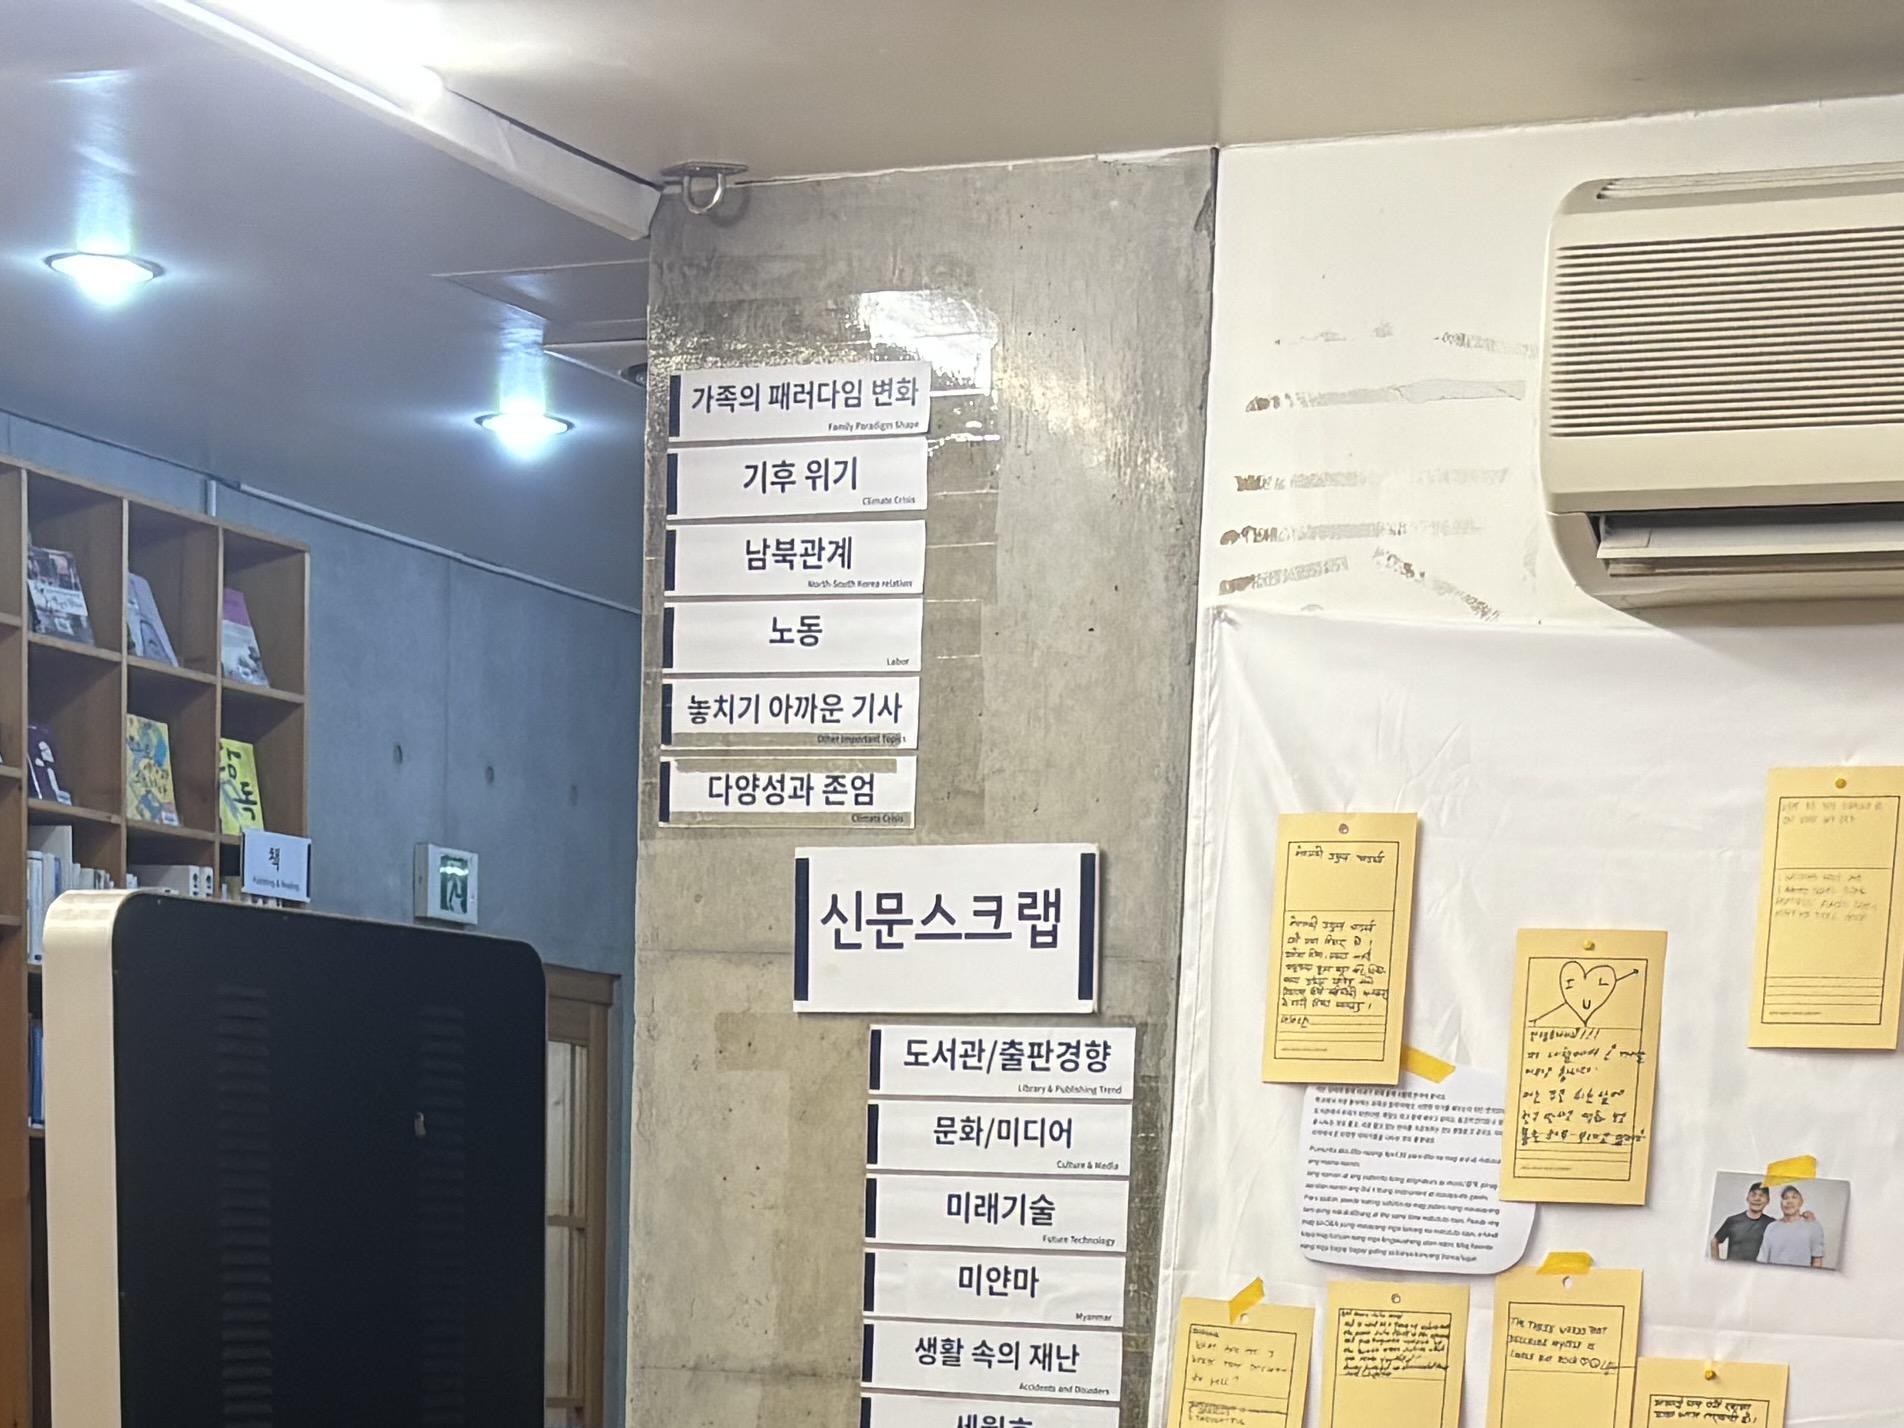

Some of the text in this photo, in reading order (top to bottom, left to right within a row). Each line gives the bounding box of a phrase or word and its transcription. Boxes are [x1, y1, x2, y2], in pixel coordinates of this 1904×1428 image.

[692, 378, 918, 414] 가족의 패러다임 변화
[744, 457, 856, 494] 기후 위기
[746, 536, 852, 570] 남북관계
[769, 616, 822, 646] 노동
[688, 692, 902, 724] 놓치기 아까운 기사
[709, 773, 874, 806] 다양성과 존엄
[268, 848, 280, 872] 책
[821, 888, 1060, 949] 신문스크랩
[904, 1038, 1111, 1074] 도서관/출판경향
[934, 1116, 1072, 1149] 문화/미디어
[948, 1192, 1055, 1226] 미래기술
[959, 1264, 1039, 1298] 미얀마
[915, 1337, 1079, 1372] 생활 속의 재난
